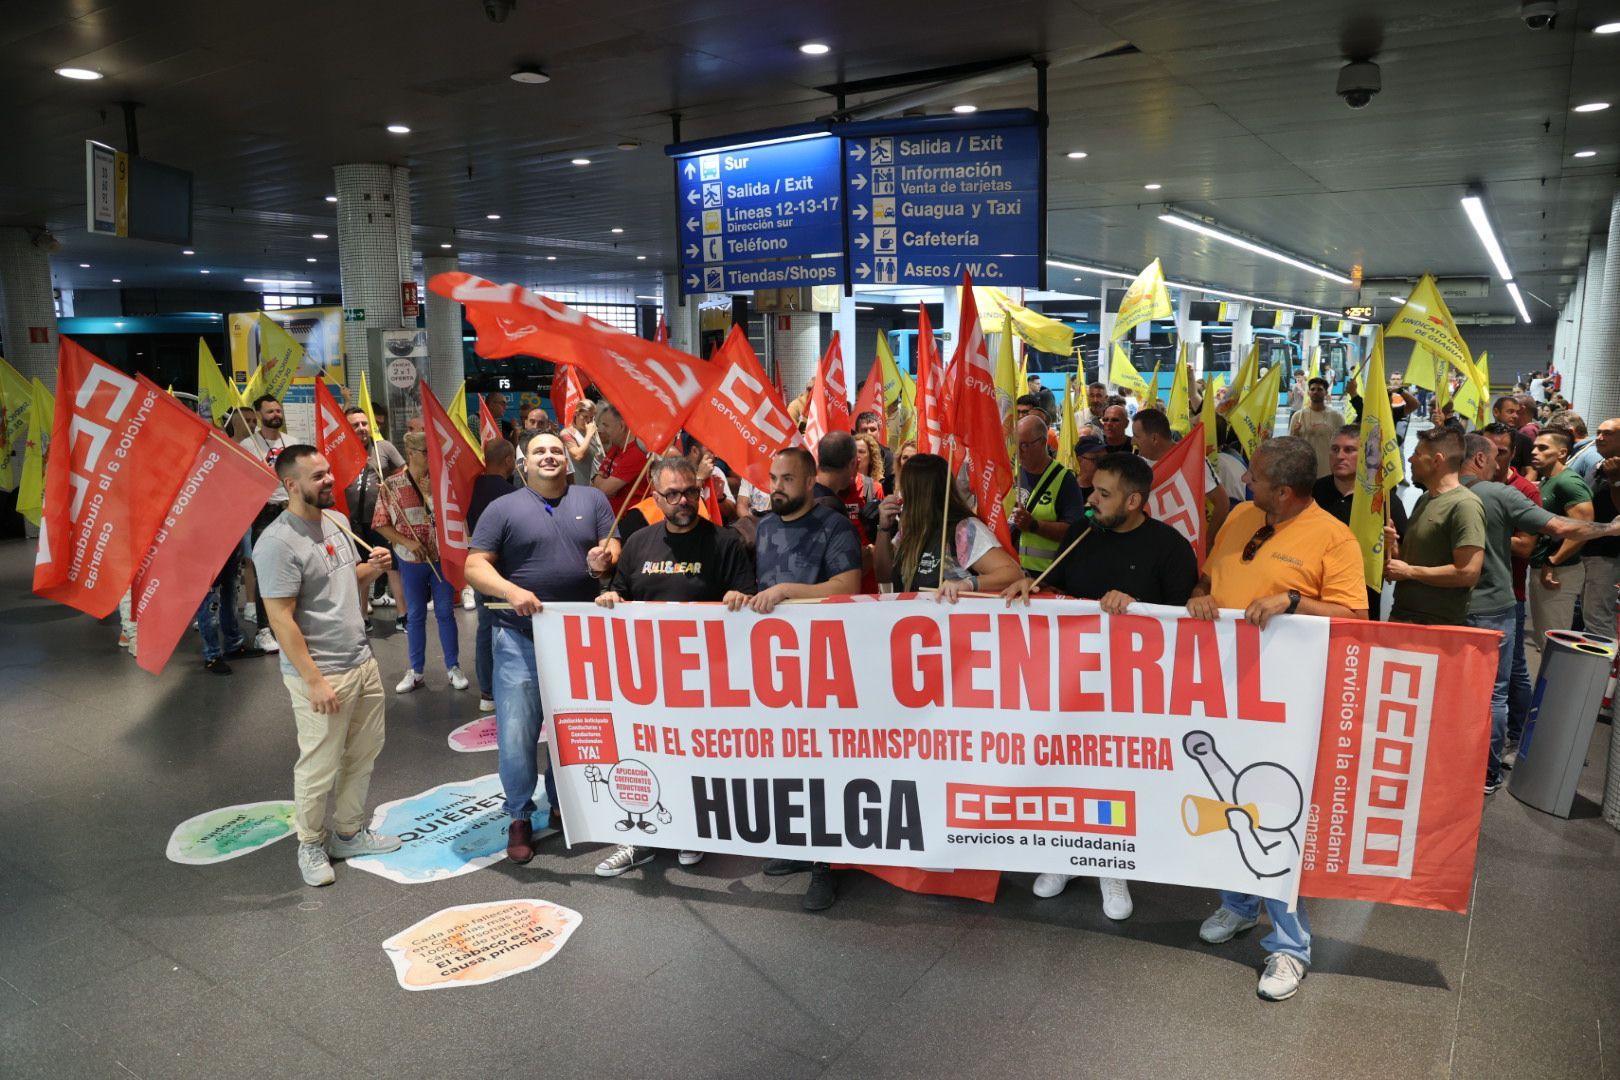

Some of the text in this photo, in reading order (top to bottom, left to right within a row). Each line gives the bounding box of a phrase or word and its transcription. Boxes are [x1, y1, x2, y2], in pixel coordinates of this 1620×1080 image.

[900, 136, 1003, 157] Salida / Exit
[725, 156, 749, 171] Sur
[901, 162, 1002, 179] Información
[727, 176, 813, 199] Salida / Exit
[901, 179, 1012, 194] Venta de tarjetas
[727, 197, 839, 222] Líneas 12-13-17
[902, 199, 1021, 220] Guagua y Taxi
[727, 219, 793, 233] Dirección sur
[728, 237, 788, 253] Teléfono
[903, 231, 979, 247] Cafetería
[728, 266, 836, 285] Tiendas/Shops
[954, 262, 961, 279] /
[966, 262, 1003, 278] W.C.
[1401, 317, 1447, 339] SINDICATO
[1414, 329, 1427, 337] DE
[966, 375, 996, 399] ervic
[711, 397, 757, 445] servicios
[759, 444, 767, 453] a
[642, 561, 701, 575] PULL&BEAR
[563, 613, 1286, 723] HUELGA GENERAL
[633, 723, 1174, 771] EN EL SECTOR DEL TRANSPORTE POR CARRETERA
[1368, 661, 1422, 810] CCOO
[578, 746, 600, 759] ¡YA!
[1326, 644, 1360, 873] servicios a la ciudadanía
[414, 795, 477, 822] No fumes
[620, 792, 648, 801] CCOO
[955, 793, 1075, 822] CCOO
[398, 792, 508, 843] QUIÉRET
[691, 776, 925, 851] HUELGA
[437, 828, 471, 844] libre
[472, 820, 488, 831] de
[947, 832, 1136, 852] servicios a la ciudadanía
[1303, 803, 1321, 871] canarias
[1070, 855, 1136, 870] canarias
[411, 905, 518, 946] Cada año fallecen
[412, 908, 529, 953] en Canarias más de
[420, 913, 533, 958] 1.000 personas por
[426, 920, 537, 964] cáncer de pulmón
[435, 925, 544, 969] El tabaco es la
[440, 929, 554, 977] causa principal
